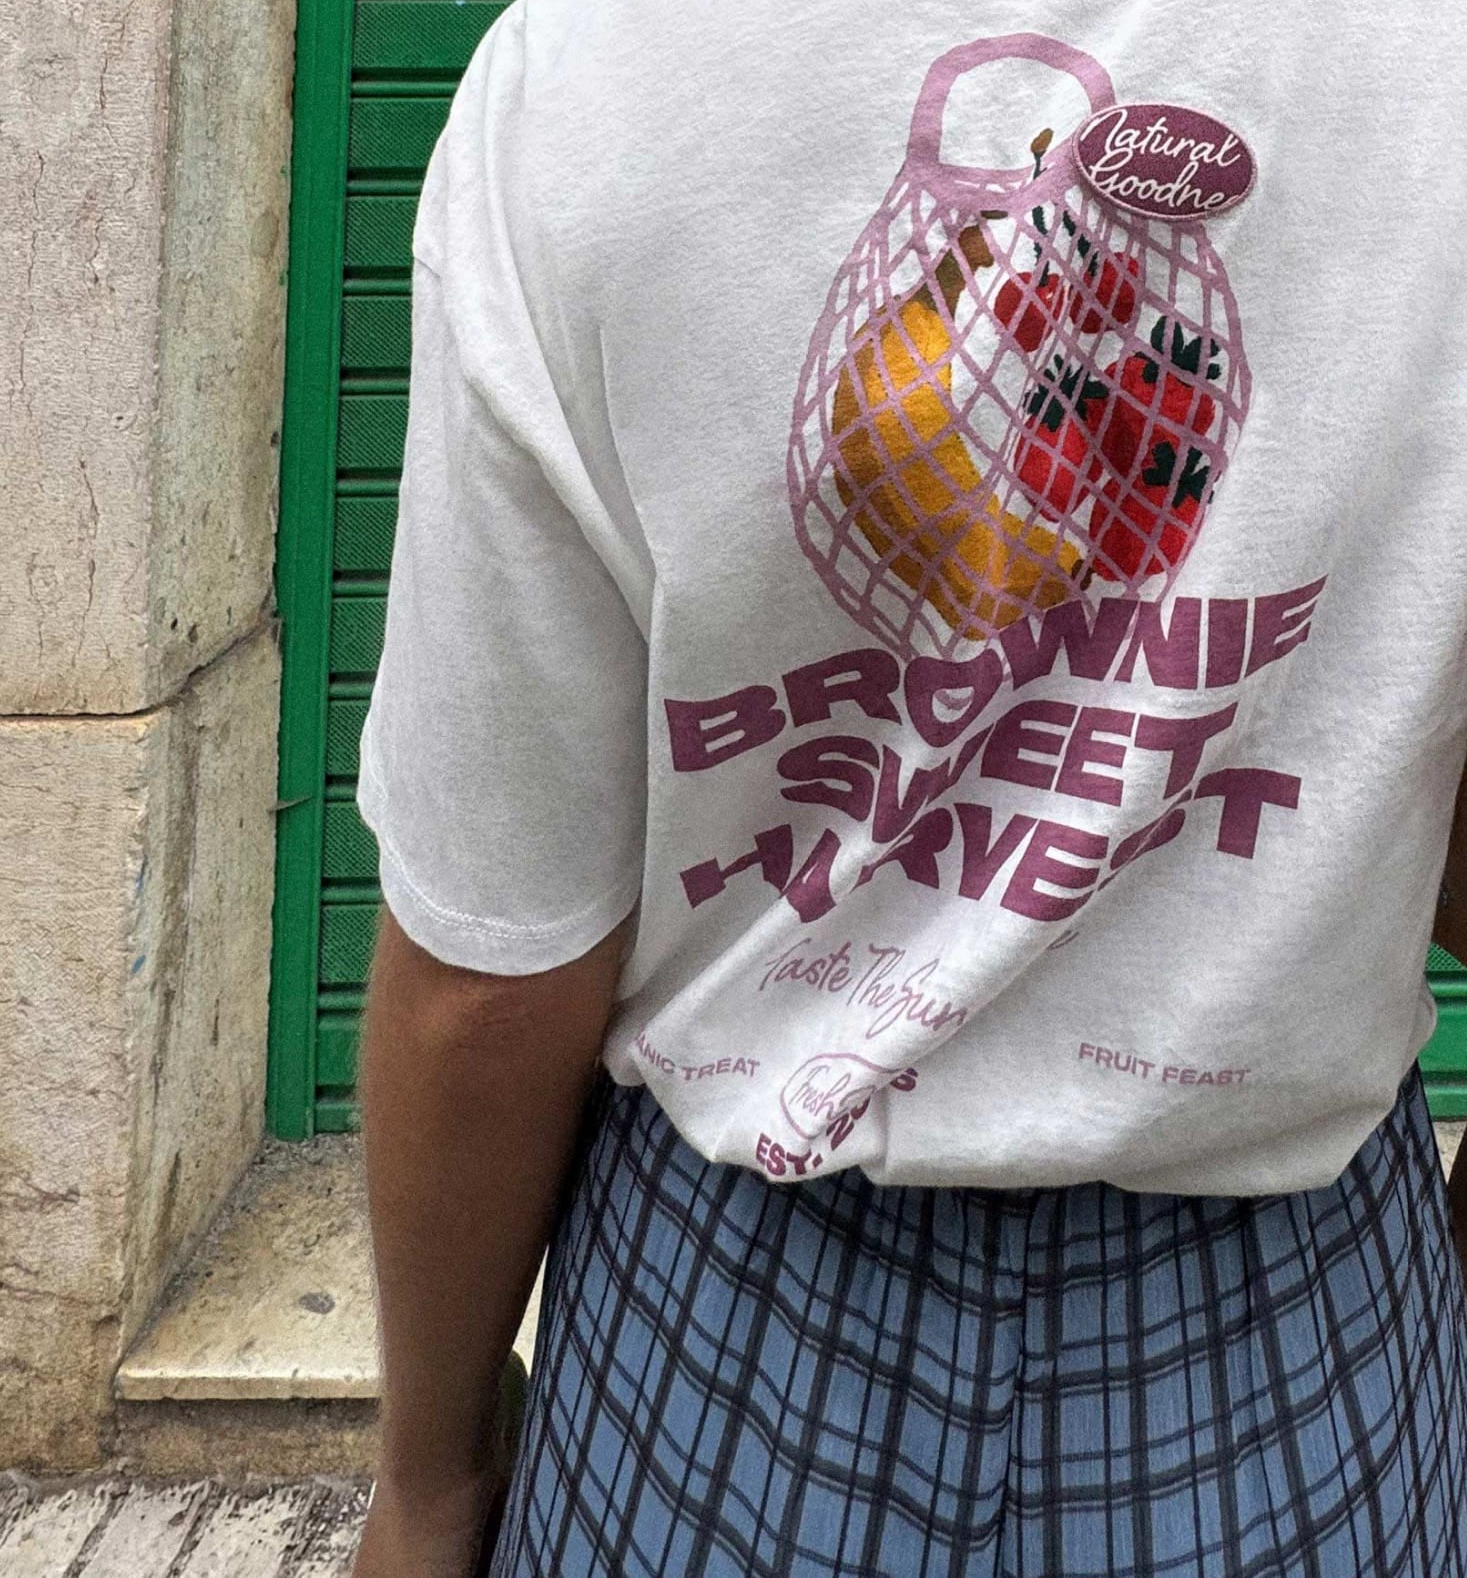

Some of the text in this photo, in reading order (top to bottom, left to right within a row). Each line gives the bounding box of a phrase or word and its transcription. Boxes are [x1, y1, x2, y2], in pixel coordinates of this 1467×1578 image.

[1079, 108, 1241, 167] Natural
[663, 573, 1329, 772] BROWNIE
[777, 699, 1238, 843] SWEET
[759, 937, 853, 993] Taste
[847, 943, 906, 1008] The
[634, 1028, 761, 1081] ANIC TREAT
[1078, 1042, 1252, 1086] FRUIT FEAST
